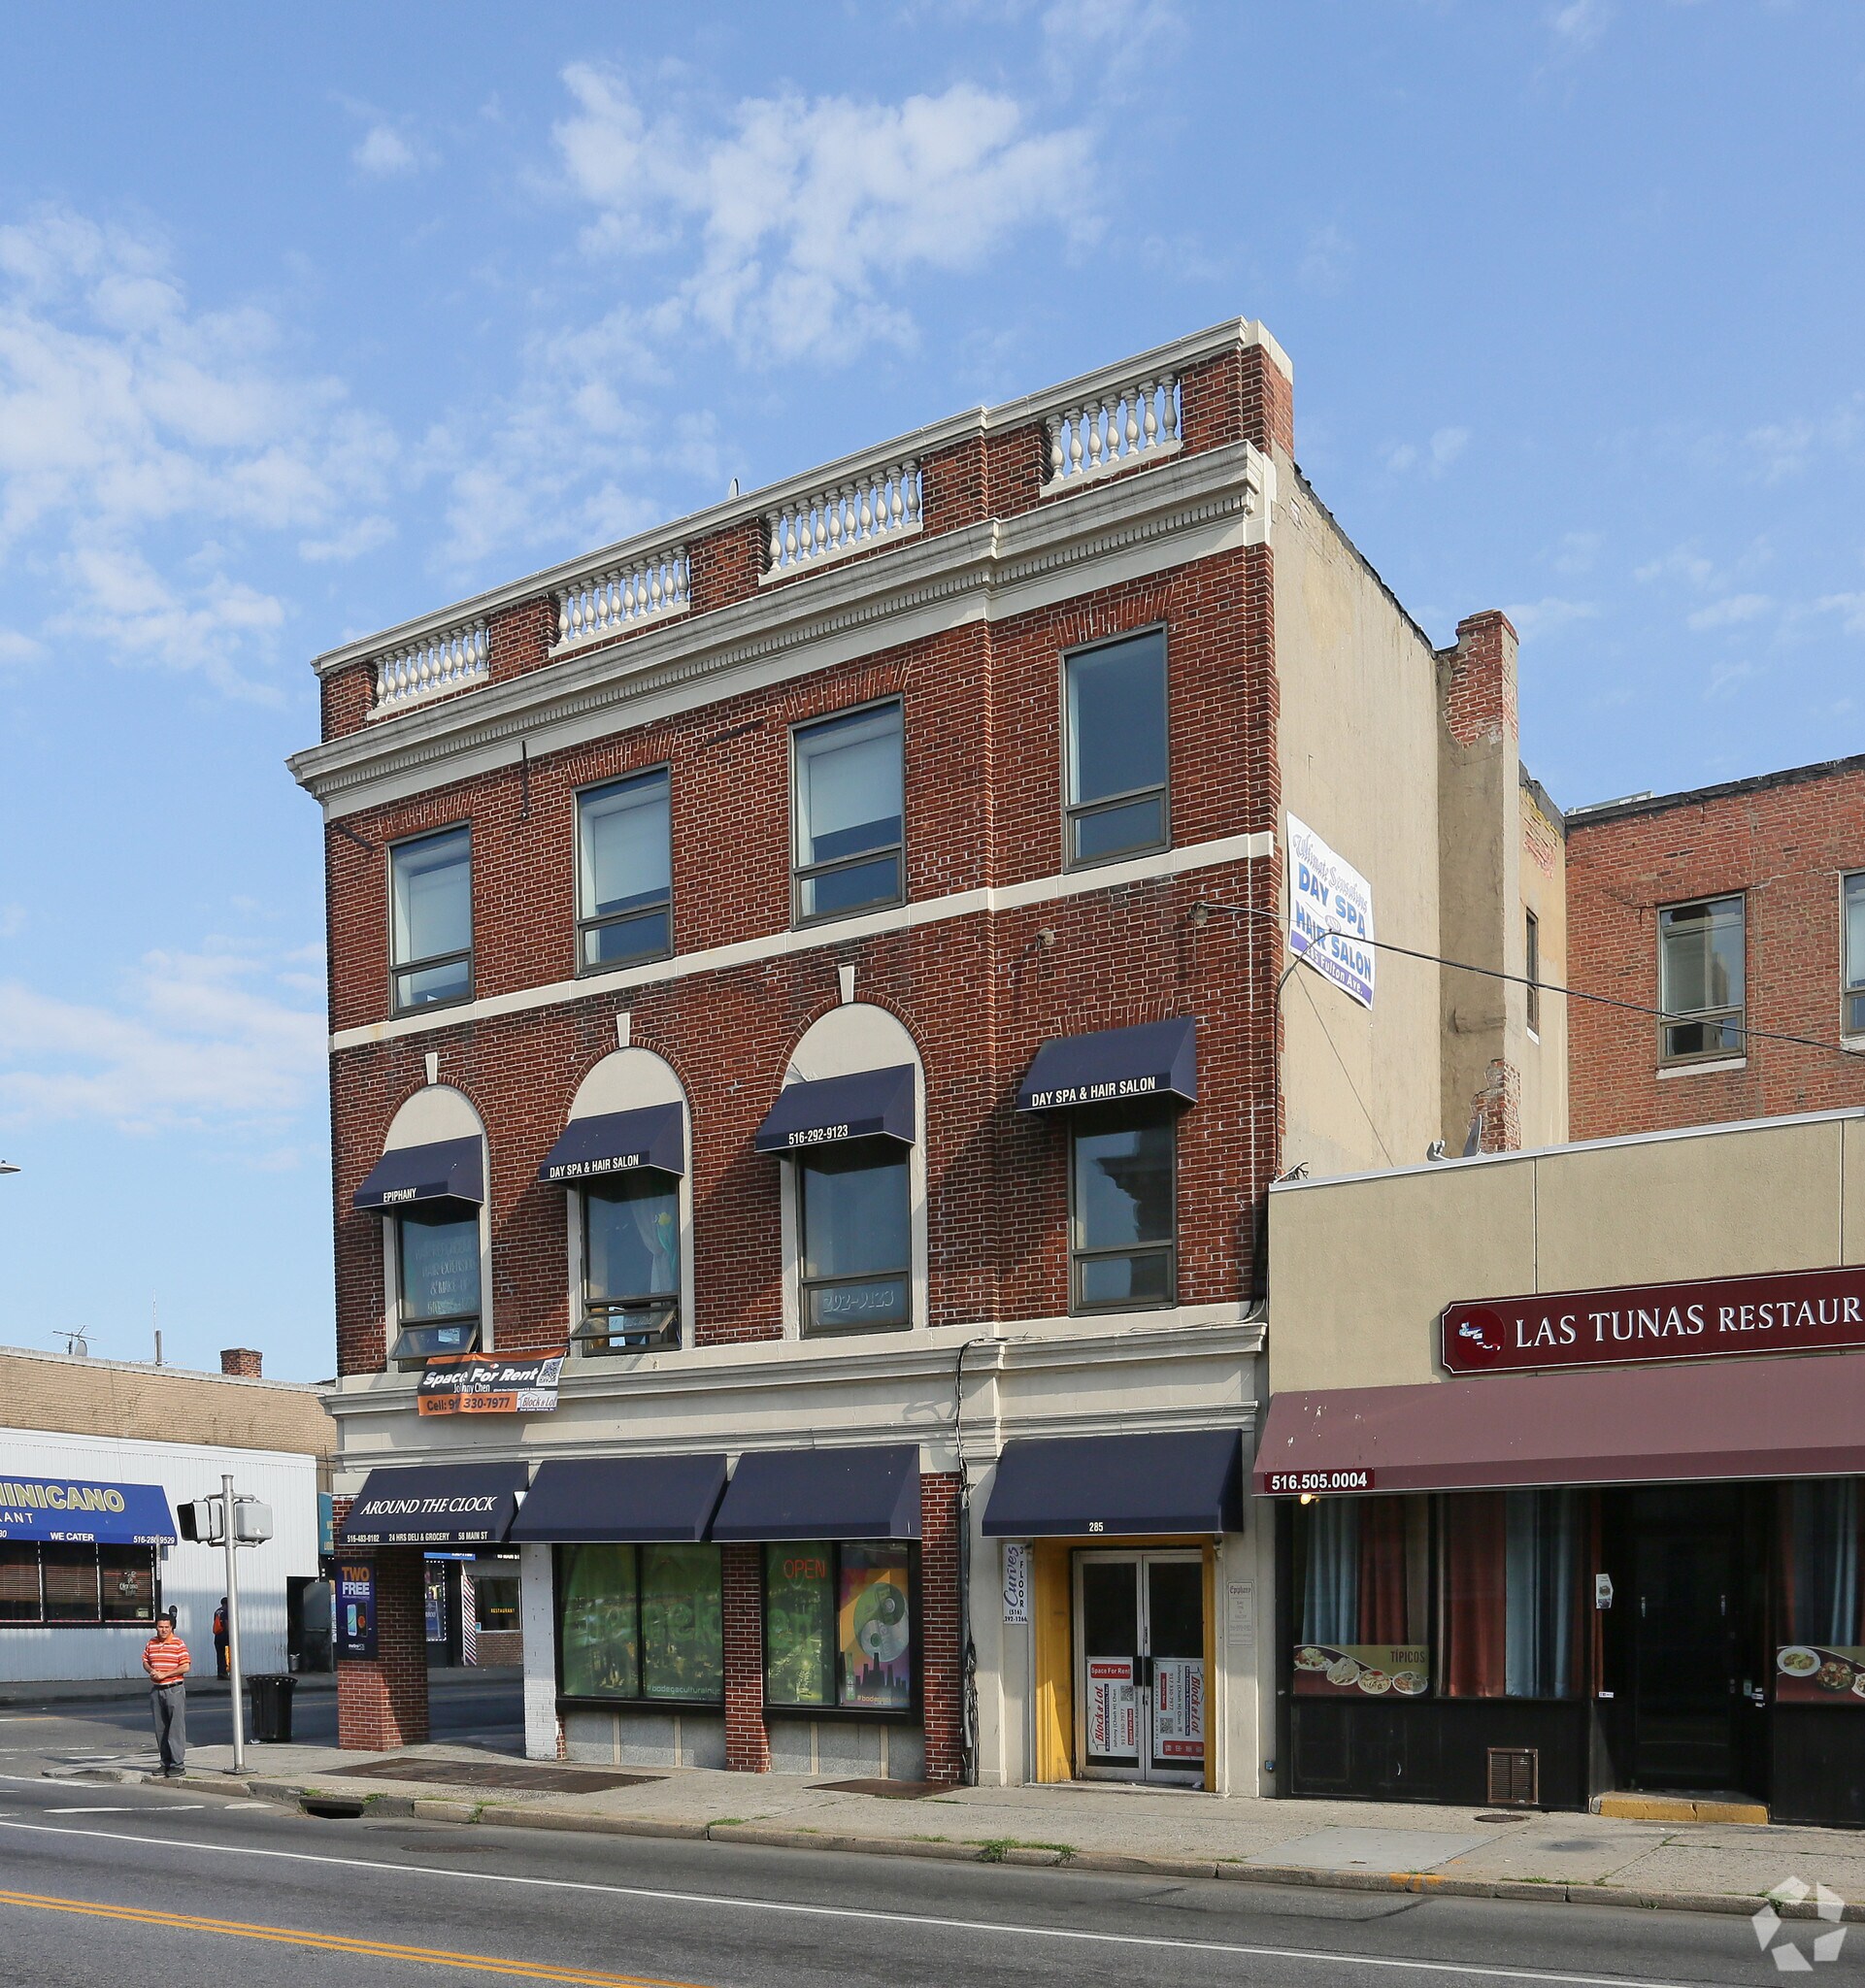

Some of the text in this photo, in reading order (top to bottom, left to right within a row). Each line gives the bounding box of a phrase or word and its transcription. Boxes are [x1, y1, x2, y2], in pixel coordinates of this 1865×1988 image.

[1299, 862, 1365, 940] DAY SPA
[1296, 900, 1371, 982] HAIR SALON
[1320, 954, 1345, 982] Fulton
[1347, 973, 1363, 994] Ave.
[1032, 1077, 1155, 1107] DAY SPA & HAIR SALON
[788, 1124, 849, 1144] 516-292-9123
[550, 1153, 639, 1178] DAY SPA & HAIR SALON
[383, 1187, 416, 1203] EPIPHANY
[1515, 1296, 1865, 1348] LAS TUNAS RESTAUR
[470, 1368, 500, 1382] For
[499, 1367, 539, 1382] Rent
[474, 1382, 490, 1393] Chen
[427, 1400, 447, 1411] Cell:
[463, 1398, 511, 1408] 330-7977
[522, 1397, 540, 1408] Block
[1272, 1472, 1367, 1490] 516.505.0004
[360, 1496, 497, 1515] AROUND THE CLOCK
[0, 1512, 33, 1524] ANT
[1088, 1521, 1104, 1532] 285
[66, 1533, 94, 1541] CATER
[408, 1533, 419, 1541] DELI
[425, 1532, 450, 1541] GROCERY
[481, 1531, 487, 1540] ST
[342, 1567, 370, 1581] TWO
[783, 1559, 826, 1579] OPEN
[1004, 1546, 1019, 1607] Curves
[342, 1582, 370, 1596] FREE
[1390, 1649, 1425, 1663] TÍPICOS
[1094, 1686, 1103, 1706] Lot
[1191, 1675, 1200, 1706] Block
[1094, 1712, 1104, 1742] Block
[1191, 1714, 1201, 1734] Lot
